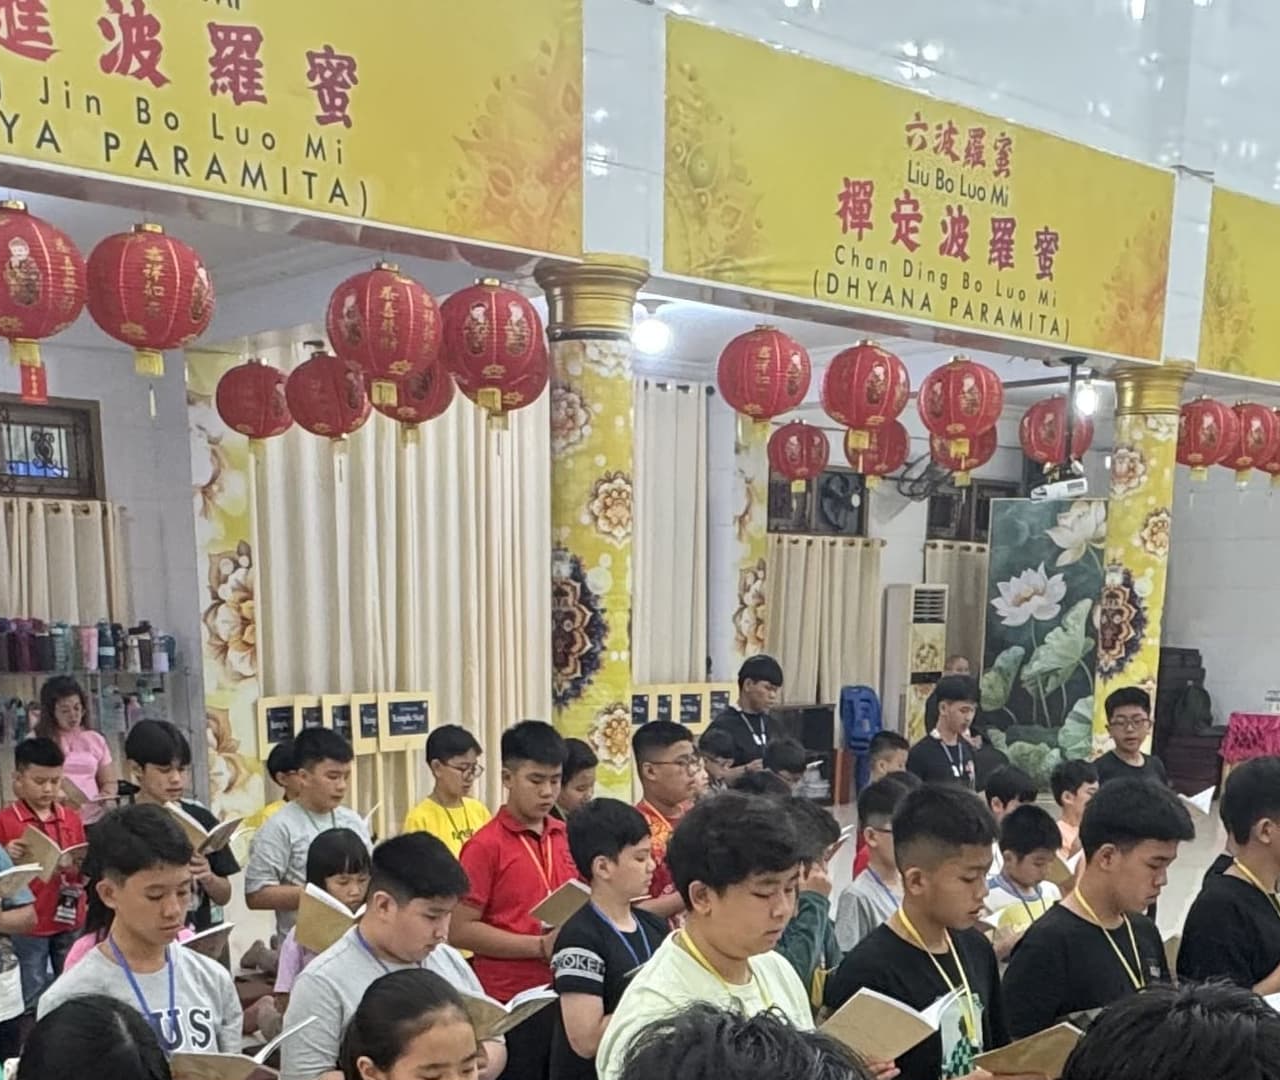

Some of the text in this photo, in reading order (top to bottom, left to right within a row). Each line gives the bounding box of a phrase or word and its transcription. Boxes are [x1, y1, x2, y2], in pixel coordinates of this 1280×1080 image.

[39, 76, 102, 116] Jin
[136, 97, 179, 131] Bo
[212, 113, 276, 151] Luo
[305, 133, 342, 164] Mi
[104, 131, 368, 217] PARAMITA)
[908, 160, 1009, 208] Liu Bo Luo Mi
[813, 269, 1070, 342] (DHYANA PARAMITA)
[835, 244, 1057, 308] Chan Ding Bo Luo Mi
